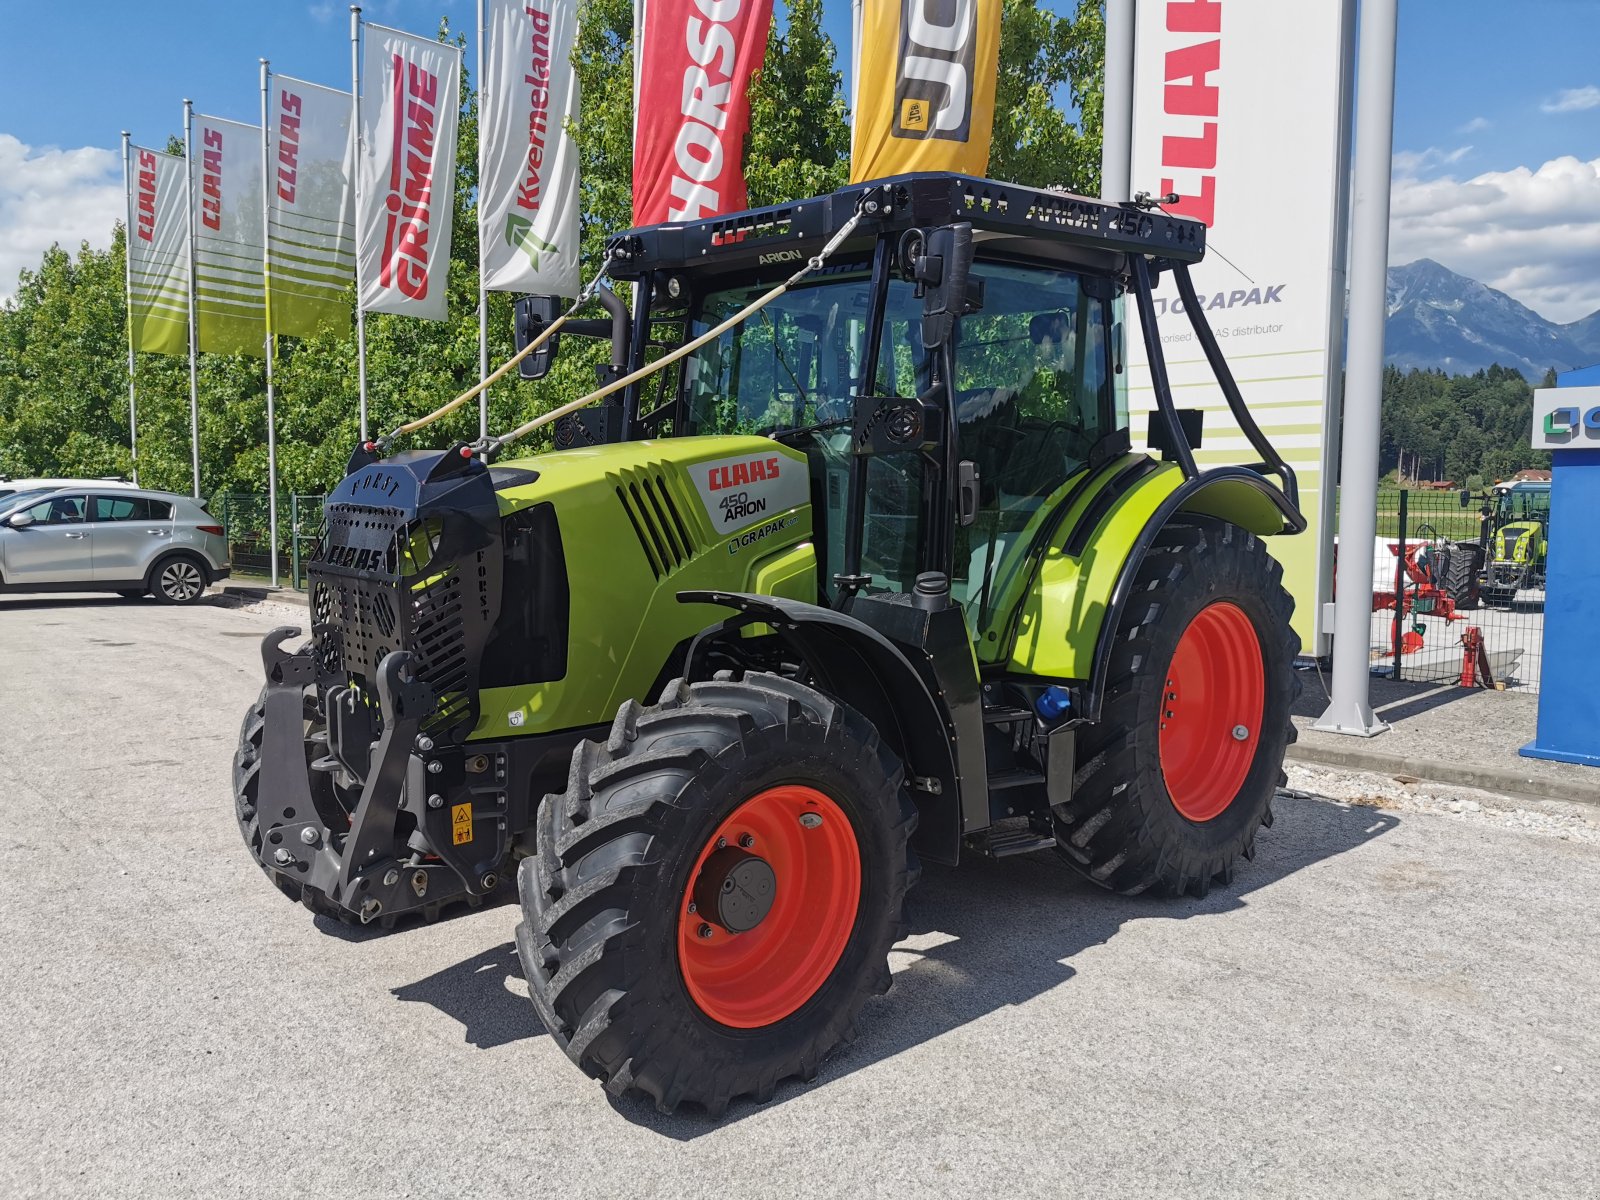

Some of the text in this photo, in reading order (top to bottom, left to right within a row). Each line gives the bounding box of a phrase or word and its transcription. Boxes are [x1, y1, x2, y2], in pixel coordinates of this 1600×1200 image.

[517, 6, 550, 211] Kverneland
[907, 102, 921, 123] JCB
[277, 89, 302, 204] CLAAS
[138, 150, 156, 242] CLAAS
[202, 127, 222, 231] CLAAS
[711, 208, 792, 246] CLAAS
[1025, 194, 1153, 239] ARION 450
[758, 249, 803, 265] ARION
[1232, 323, 1284, 337] distributor
[350, 472, 400, 497] FORST
[708, 457, 780, 491] CLAAS
[719, 491, 748, 510] 450
[724, 498, 767, 523] ARION
[327, 545, 383, 572] CLAAS
[476, 550, 491, 621] FORST
